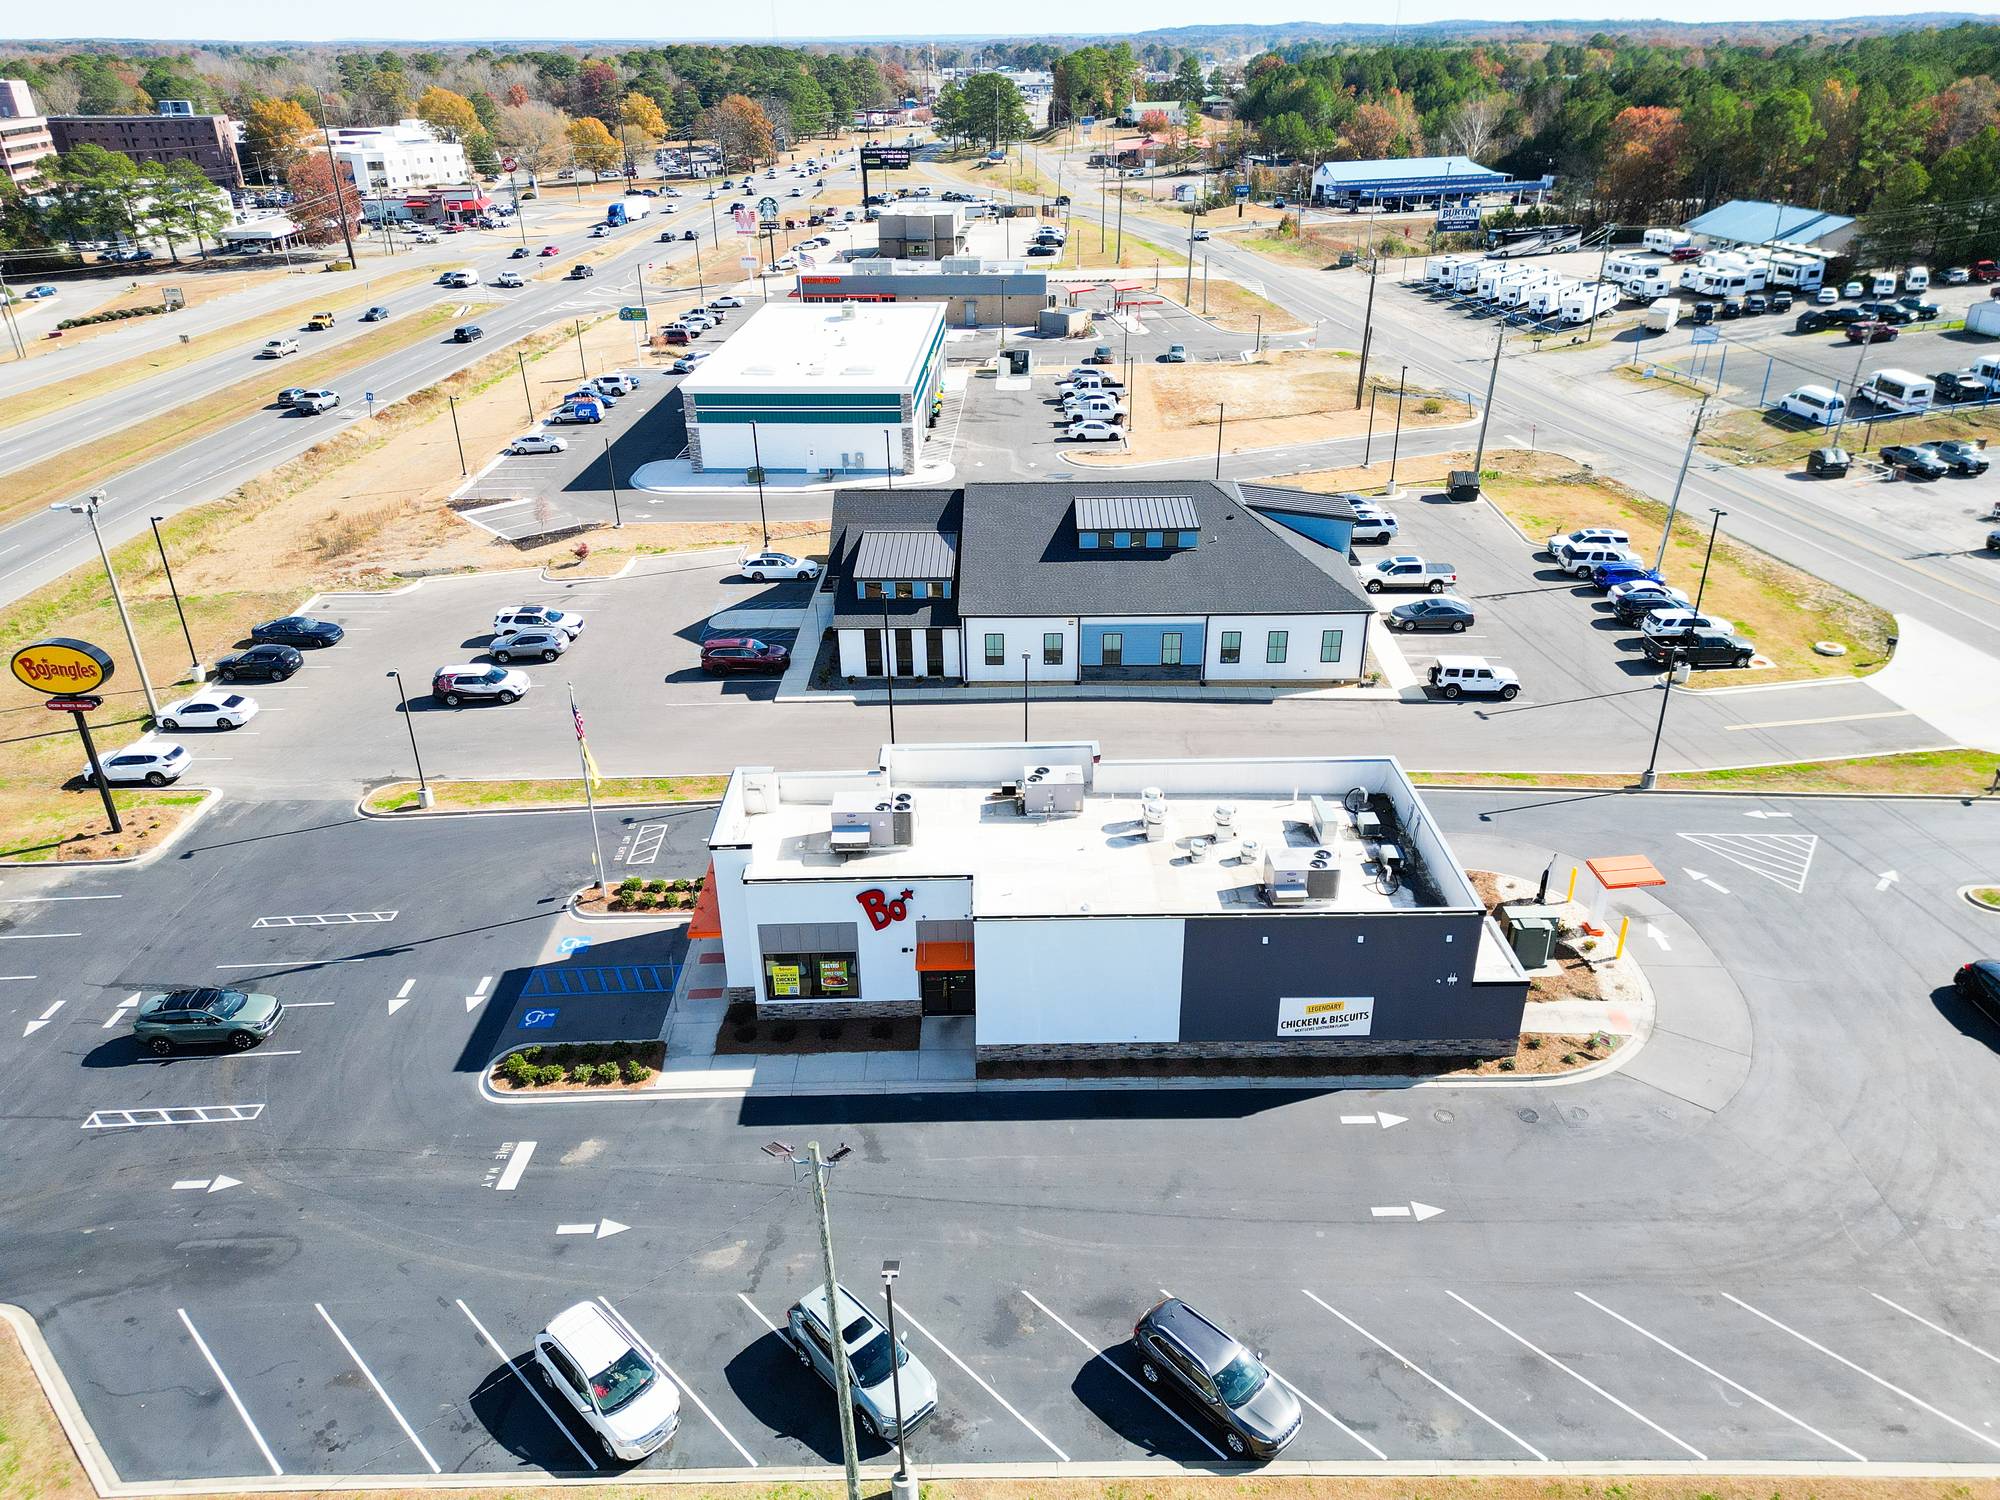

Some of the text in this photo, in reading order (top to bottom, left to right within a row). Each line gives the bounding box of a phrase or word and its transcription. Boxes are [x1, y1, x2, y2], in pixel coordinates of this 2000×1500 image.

[1442, 208, 1477, 219] BURTON
[17, 656, 98, 681] Bojangles
[1307, 1003, 1342, 1013] LEGENDARY
[1280, 1011, 1369, 1029] CHICKEN & BISCUITS
[481, 1167, 500, 1188] WAY
